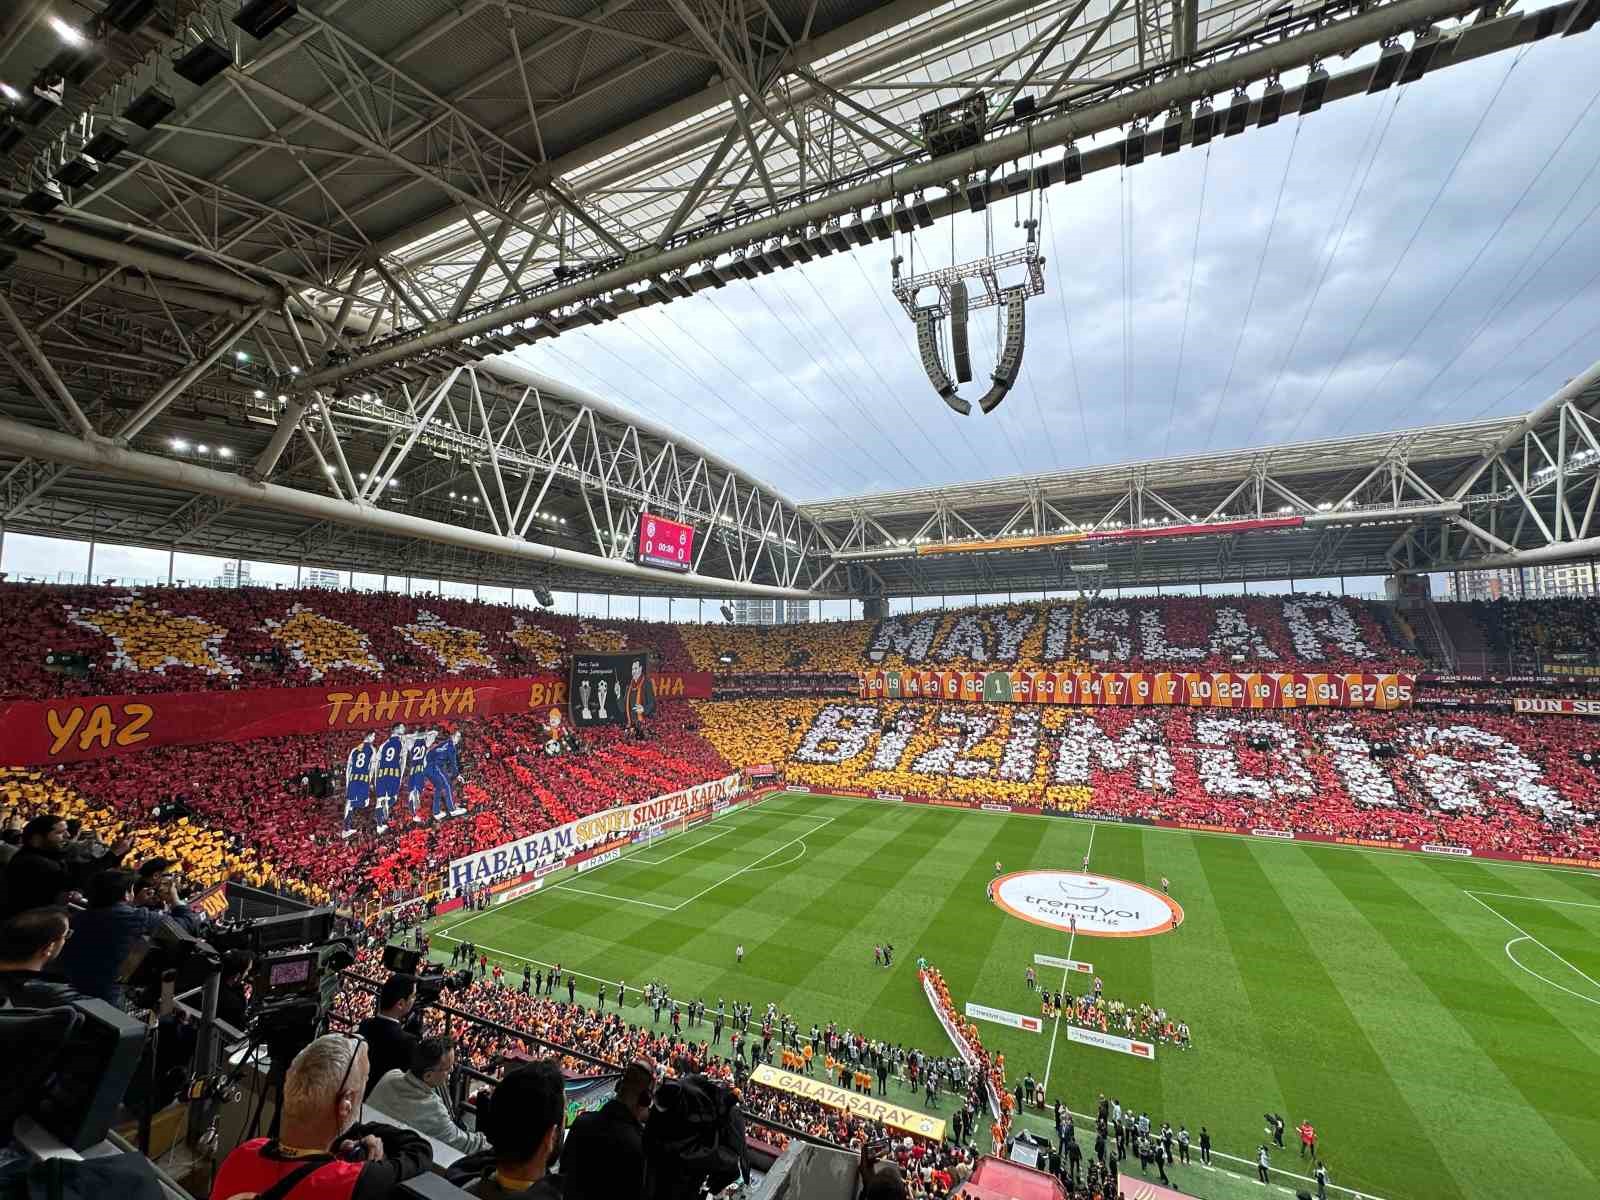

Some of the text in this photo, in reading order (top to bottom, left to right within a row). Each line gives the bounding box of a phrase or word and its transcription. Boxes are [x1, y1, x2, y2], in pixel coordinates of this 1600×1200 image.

[645, 540, 653, 553] 0
[868, 678, 882, 690] 20
[888, 677, 899, 689] 19
[904, 678, 917, 691] 14
[948, 679, 957, 693] 6
[966, 679, 983, 693] 92
[994, 679, 1002, 693] 1
[1013, 680, 1029, 694] 25
[1038, 680, 1054, 693] 53
[1063, 680, 1073, 694] 8
[1080, 679, 1100, 694] 34
[1108, 681, 1123, 695] 17
[1137, 681, 1149, 696] 9
[1166, 680, 1177, 695] 7
[1190, 680, 1212, 698] 10
[1219, 682, 1243, 699] 22
[1254, 683, 1270, 698] 18
[1282, 681, 1307, 699] 42
[1318, 683, 1341, 700] 91
[1349, 683, 1377, 701] 27
[1385, 684, 1411, 701] 95
[47, 703, 153, 755] YAZ
[327, 686, 477, 726] TAHTAYA
[355, 752, 366, 768] 8
[385, 747, 395, 762] 9
[412, 746, 426, 760] 20
[451, 826, 575, 890] HABABAM
[633, 793, 688, 825] SINIFTA
[590, 850, 618, 867] RAMS
[1025, 895, 1139, 920] trendyol
[779, 1075, 913, 1125] GALATASARAY
